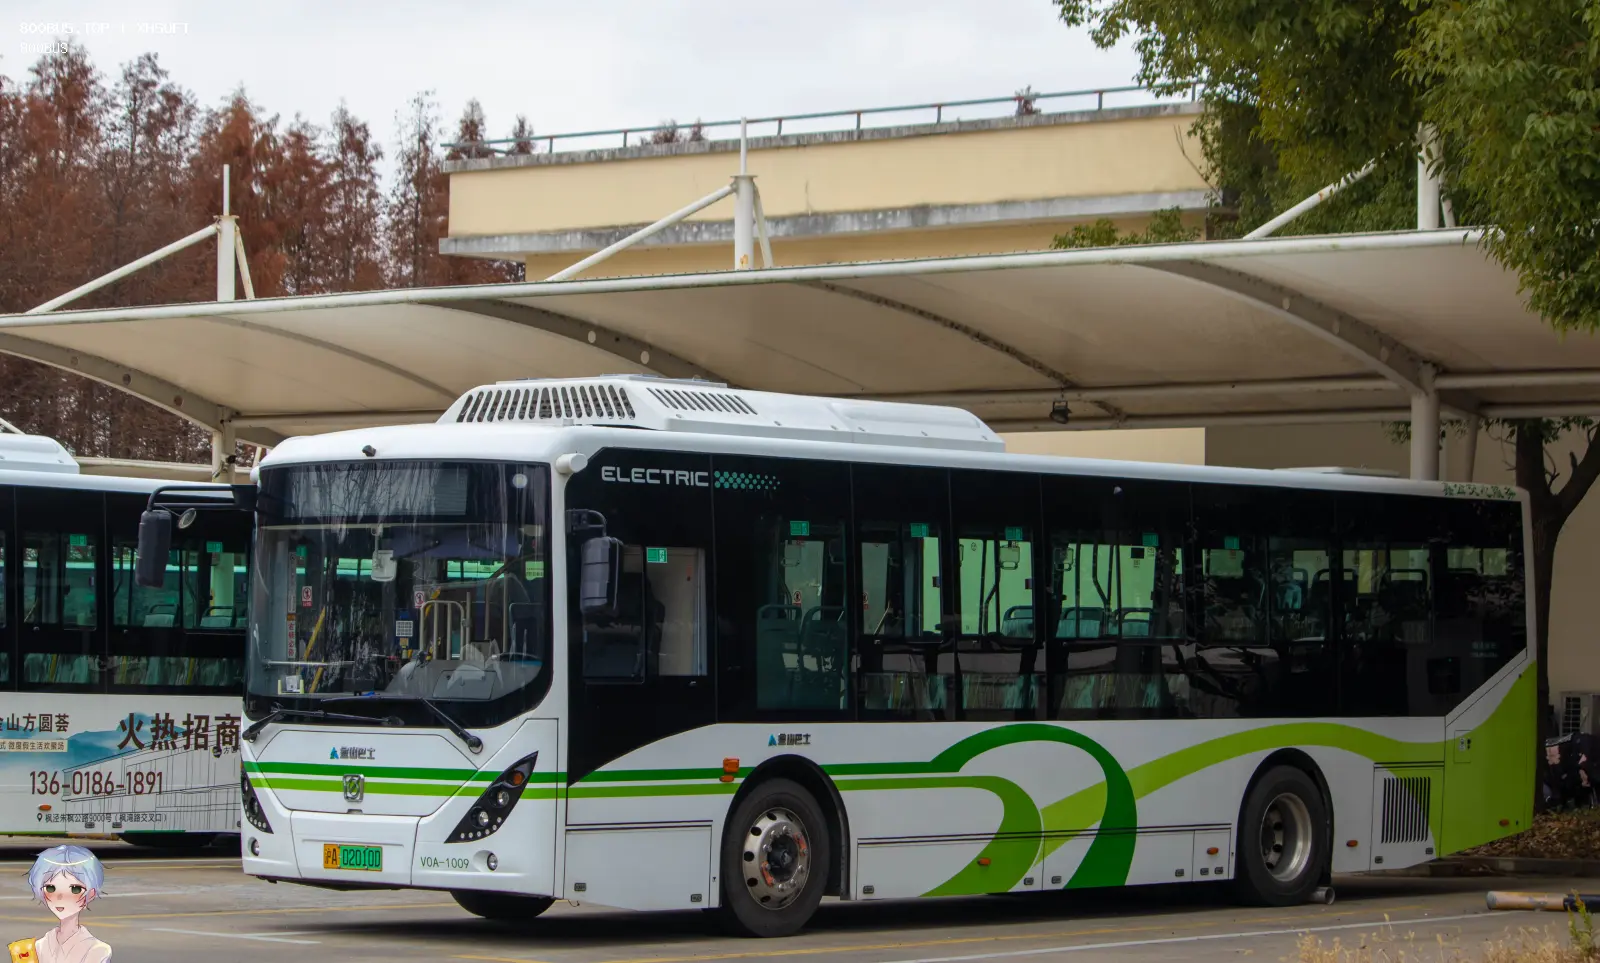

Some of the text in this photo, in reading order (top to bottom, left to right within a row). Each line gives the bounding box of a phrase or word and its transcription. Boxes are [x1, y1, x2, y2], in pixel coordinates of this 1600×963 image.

[601, 466, 709, 487] ELECTRIC
[0, 713, 70, 733] 山方圆荟
[117, 712, 241, 751] 火热招商
[29, 771, 163, 795] 136-0186-1891
